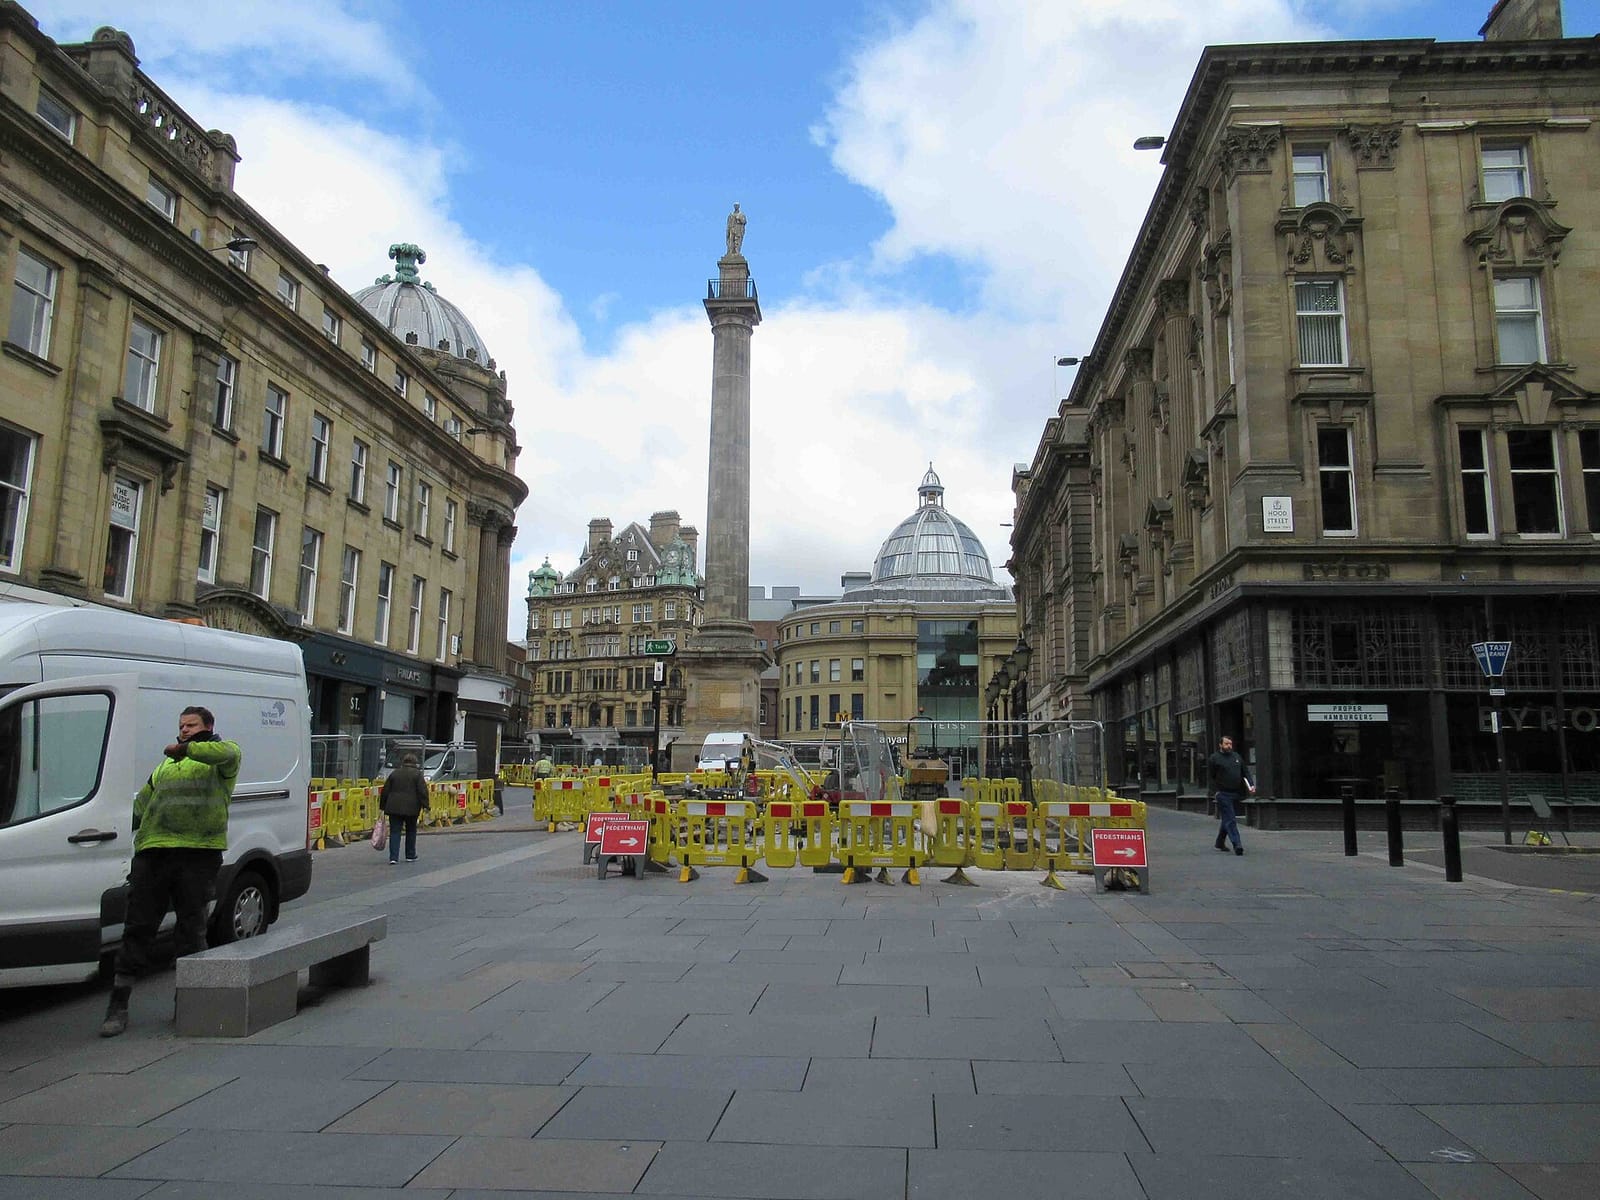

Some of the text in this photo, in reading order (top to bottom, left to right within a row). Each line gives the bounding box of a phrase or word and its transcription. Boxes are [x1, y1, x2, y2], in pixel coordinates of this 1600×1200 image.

[115, 486, 129, 497] THE
[113, 493, 131, 505] MUSIC
[879, 735, 908, 745] anyan
